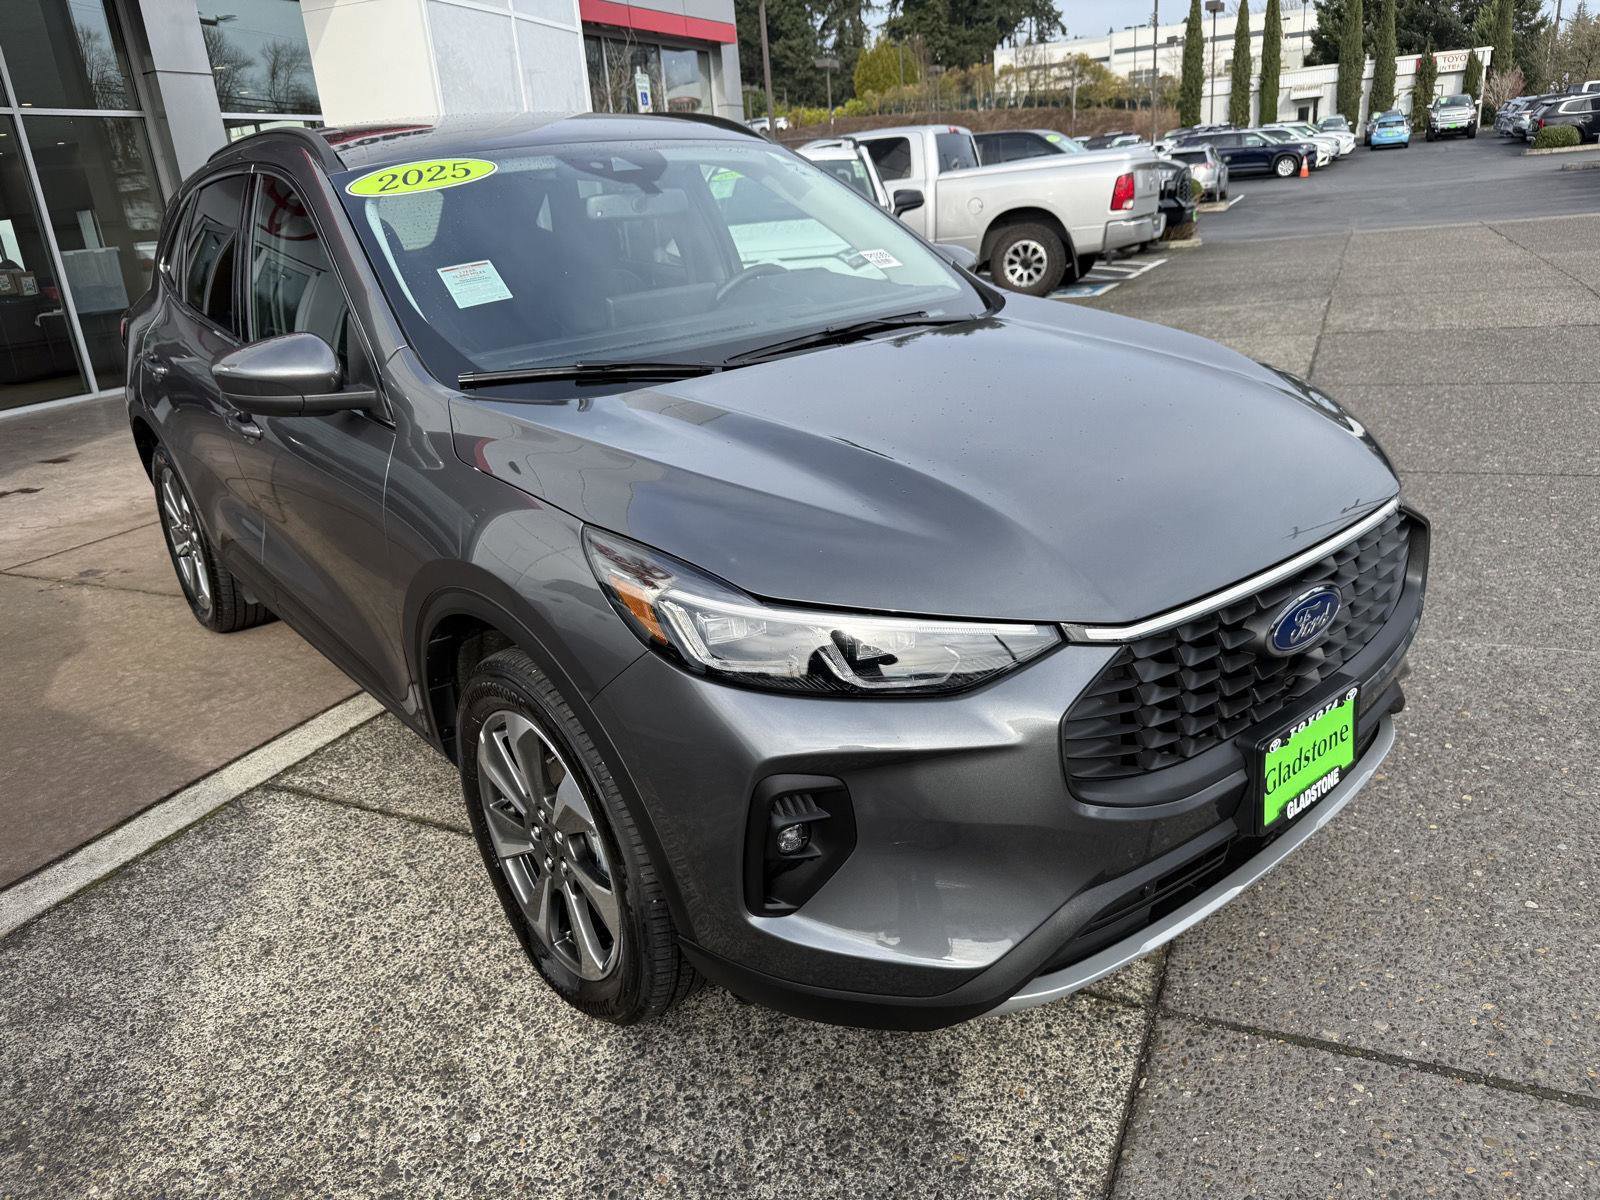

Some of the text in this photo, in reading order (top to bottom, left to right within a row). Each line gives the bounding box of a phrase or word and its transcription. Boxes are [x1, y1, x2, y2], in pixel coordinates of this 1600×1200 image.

[1443, 54, 1467, 63] TOYO
[378, 162, 471, 192] 2025
[1290, 600, 1331, 644] Ford
[1290, 699, 1339, 739] TOYOTA
[1265, 723, 1349, 796] Gladstone
[1286, 767, 1340, 820] GLADSTONE
